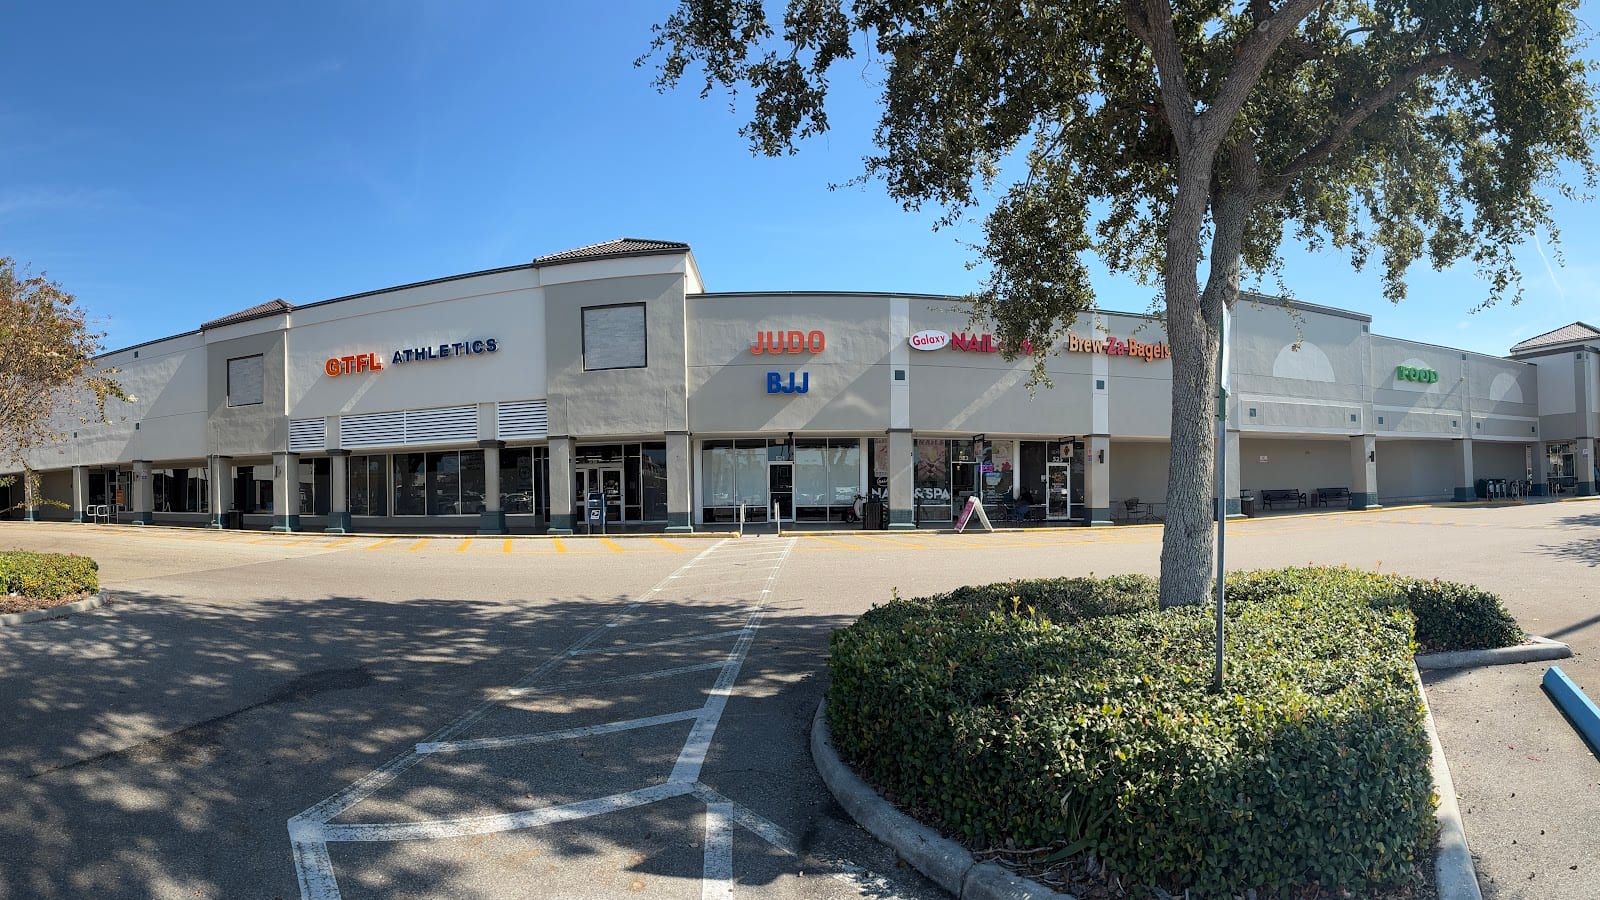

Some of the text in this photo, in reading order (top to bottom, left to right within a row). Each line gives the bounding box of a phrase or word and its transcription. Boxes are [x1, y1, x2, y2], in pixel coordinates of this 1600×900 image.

[750, 330, 825, 354] JUDO
[912, 334, 945, 346] Galaxy
[951, 332, 1005, 353] NAIL
[1068, 333, 1171, 362] Brew-Za-Bagels
[325, 338, 498, 377] GTFL ATHLETICS
[767, 372, 809, 394] BJJ
[926, 488, 950, 499] SPA
